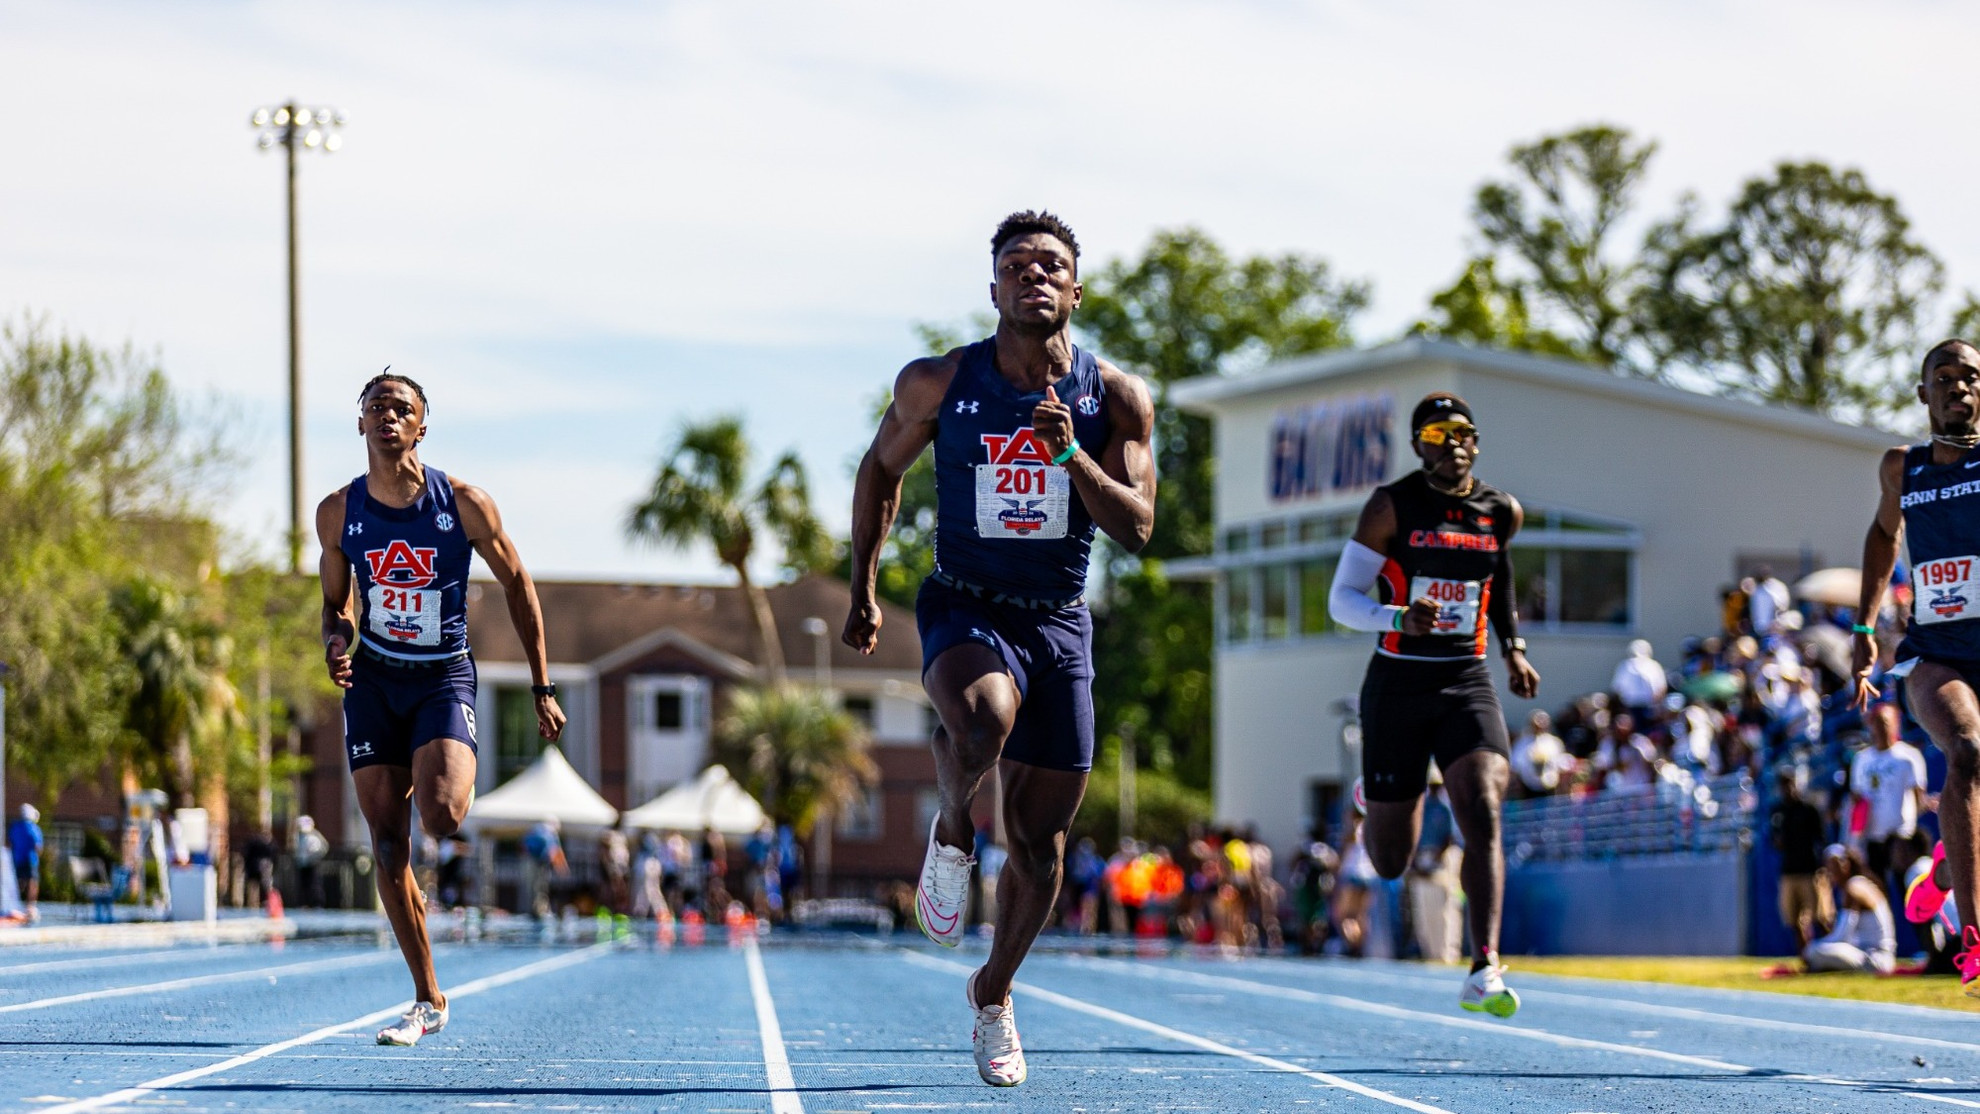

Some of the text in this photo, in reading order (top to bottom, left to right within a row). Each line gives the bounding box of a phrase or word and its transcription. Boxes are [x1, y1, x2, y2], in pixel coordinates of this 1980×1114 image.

[1078, 396, 1100, 415] SEC
[996, 468, 1046, 495] 201
[1900, 489, 1937, 509] PENN
[436, 513, 453, 532] SEC
[1920, 559, 1972, 587] 1997
[383, 589, 423, 612] 211
[1427, 581, 1466, 602] 408
